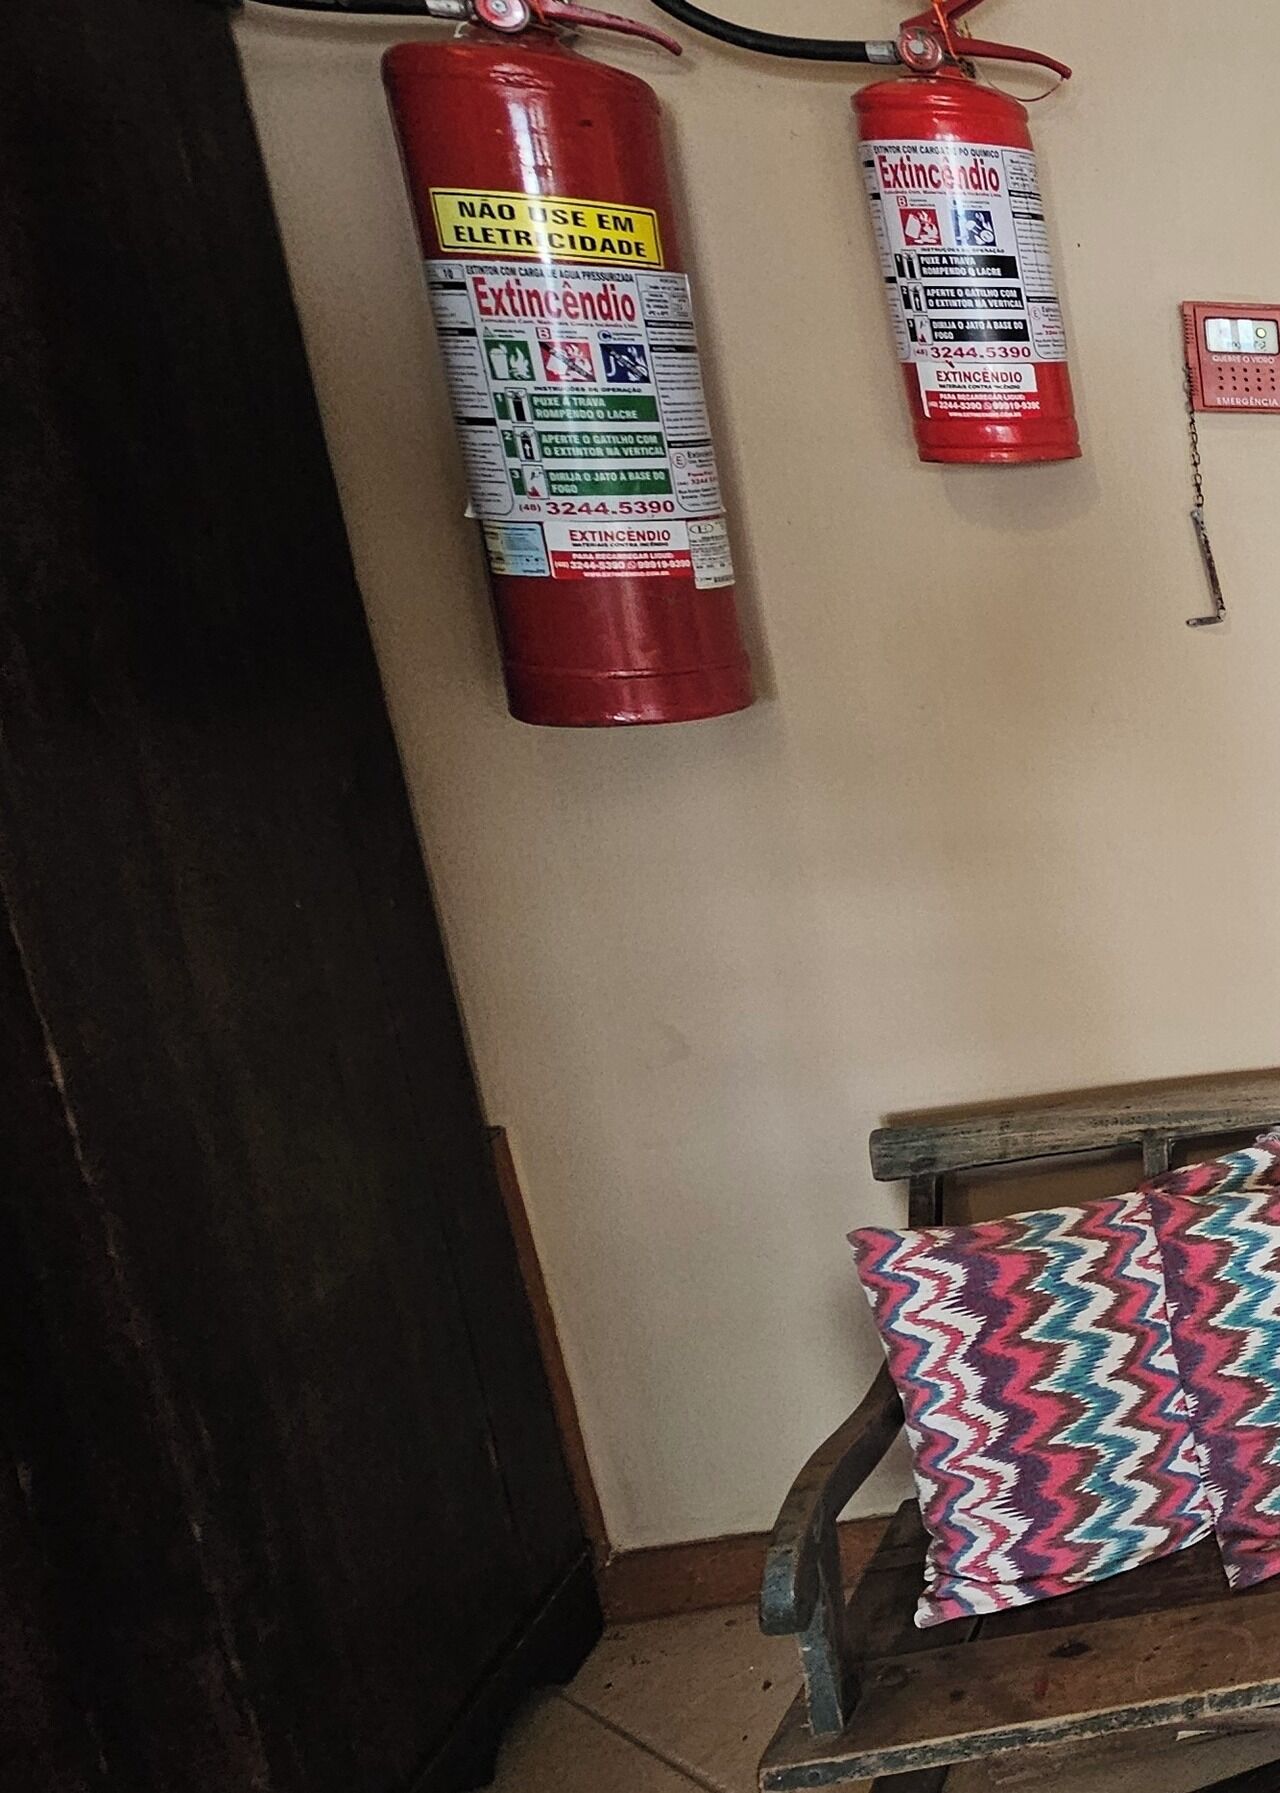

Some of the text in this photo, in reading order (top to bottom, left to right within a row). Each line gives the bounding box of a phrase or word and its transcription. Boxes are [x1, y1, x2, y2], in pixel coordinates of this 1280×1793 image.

[902, 145, 918, 154] COM
[877, 154, 1001, 192] Extincêndio
[458, 198, 635, 234] NÃO USE EM
[920, 256, 976, 265] PUXE A TRAVA
[500, 266, 517, 276] COM
[922, 267, 967, 276] ROMPENDO
[976, 267, 1002, 277] LACRE
[902, 287, 908, 295] 2
[926, 288, 955, 297] APERTE
[957, 289, 964, 297] O
[1000, 289, 1018, 298] COM
[472, 275, 637, 322] Extincêndio
[928, 299, 935, 307] O
[935, 299, 975, 308] EXTINTOR
[975, 299, 988, 308] NA
[988, 300, 1024, 309] VERTICAL
[908, 320, 914, 328] 3
[957, 321, 964, 329] O
[965, 321, 985, 329] JATO
[993, 321, 1012, 329] BASE
[538, 328, 550, 338] B
[934, 331, 954, 340] FOGO
[930, 347, 1031, 358] 3244.5390
[1242, 355, 1251, 364] O
[935, 367, 1023, 383] EXTINCÊNDIO
[533, 396, 606, 407] PUXE A TRAVA
[1216, 396, 1279, 406] EMERGÊNCIA
[535, 409, 639, 420] ROMPENDO O LACRE
[504, 431, 513, 441] 2
[542, 434, 580, 444] APERTE
[583, 434, 591, 444] O
[592, 434, 634, 444] GATILHO
[636, 435, 659, 445] COM
[544, 446, 665, 456] O EXTINTOR NA VERTICAL
[512, 469, 520, 479] 3
[583, 472, 592, 481] O
[592, 472, 617, 481] JATO
[629, 471, 651, 481] BASE
[653, 471, 665, 480] DO
[551, 484, 578, 494] FOGO
[545, 500, 675, 515] 3244.5390
[568, 526, 671, 541] EXTINCÊNDIO
[570, 560, 626, 570] 3244-5390
